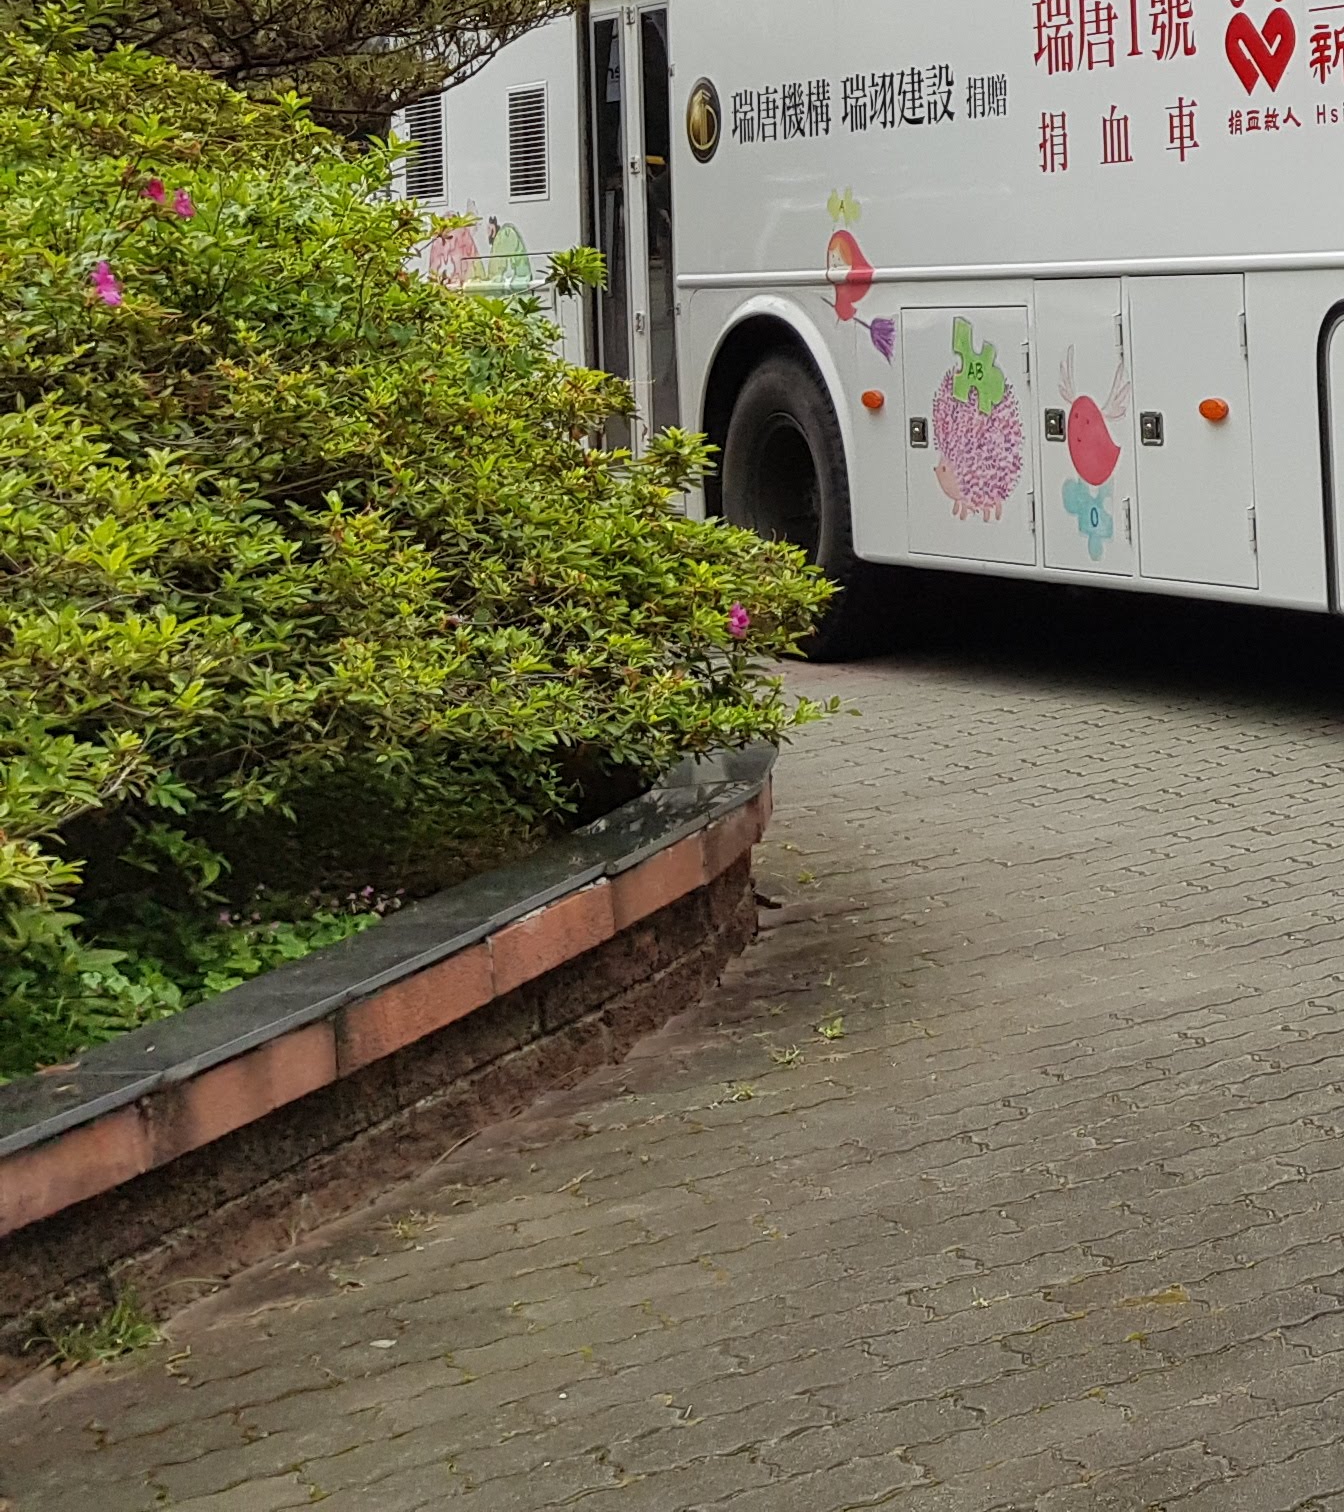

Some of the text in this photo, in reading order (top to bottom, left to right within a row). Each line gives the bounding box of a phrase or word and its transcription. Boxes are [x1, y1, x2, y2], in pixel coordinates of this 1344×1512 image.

[731, 63, 1007, 144] 瑞唐機構 瑞翊建設 捐贈
[1228, 106, 1302, 135] 捐血救人
[1038, 97, 1200, 172] 捐血車
[967, 362, 984, 381] AB
